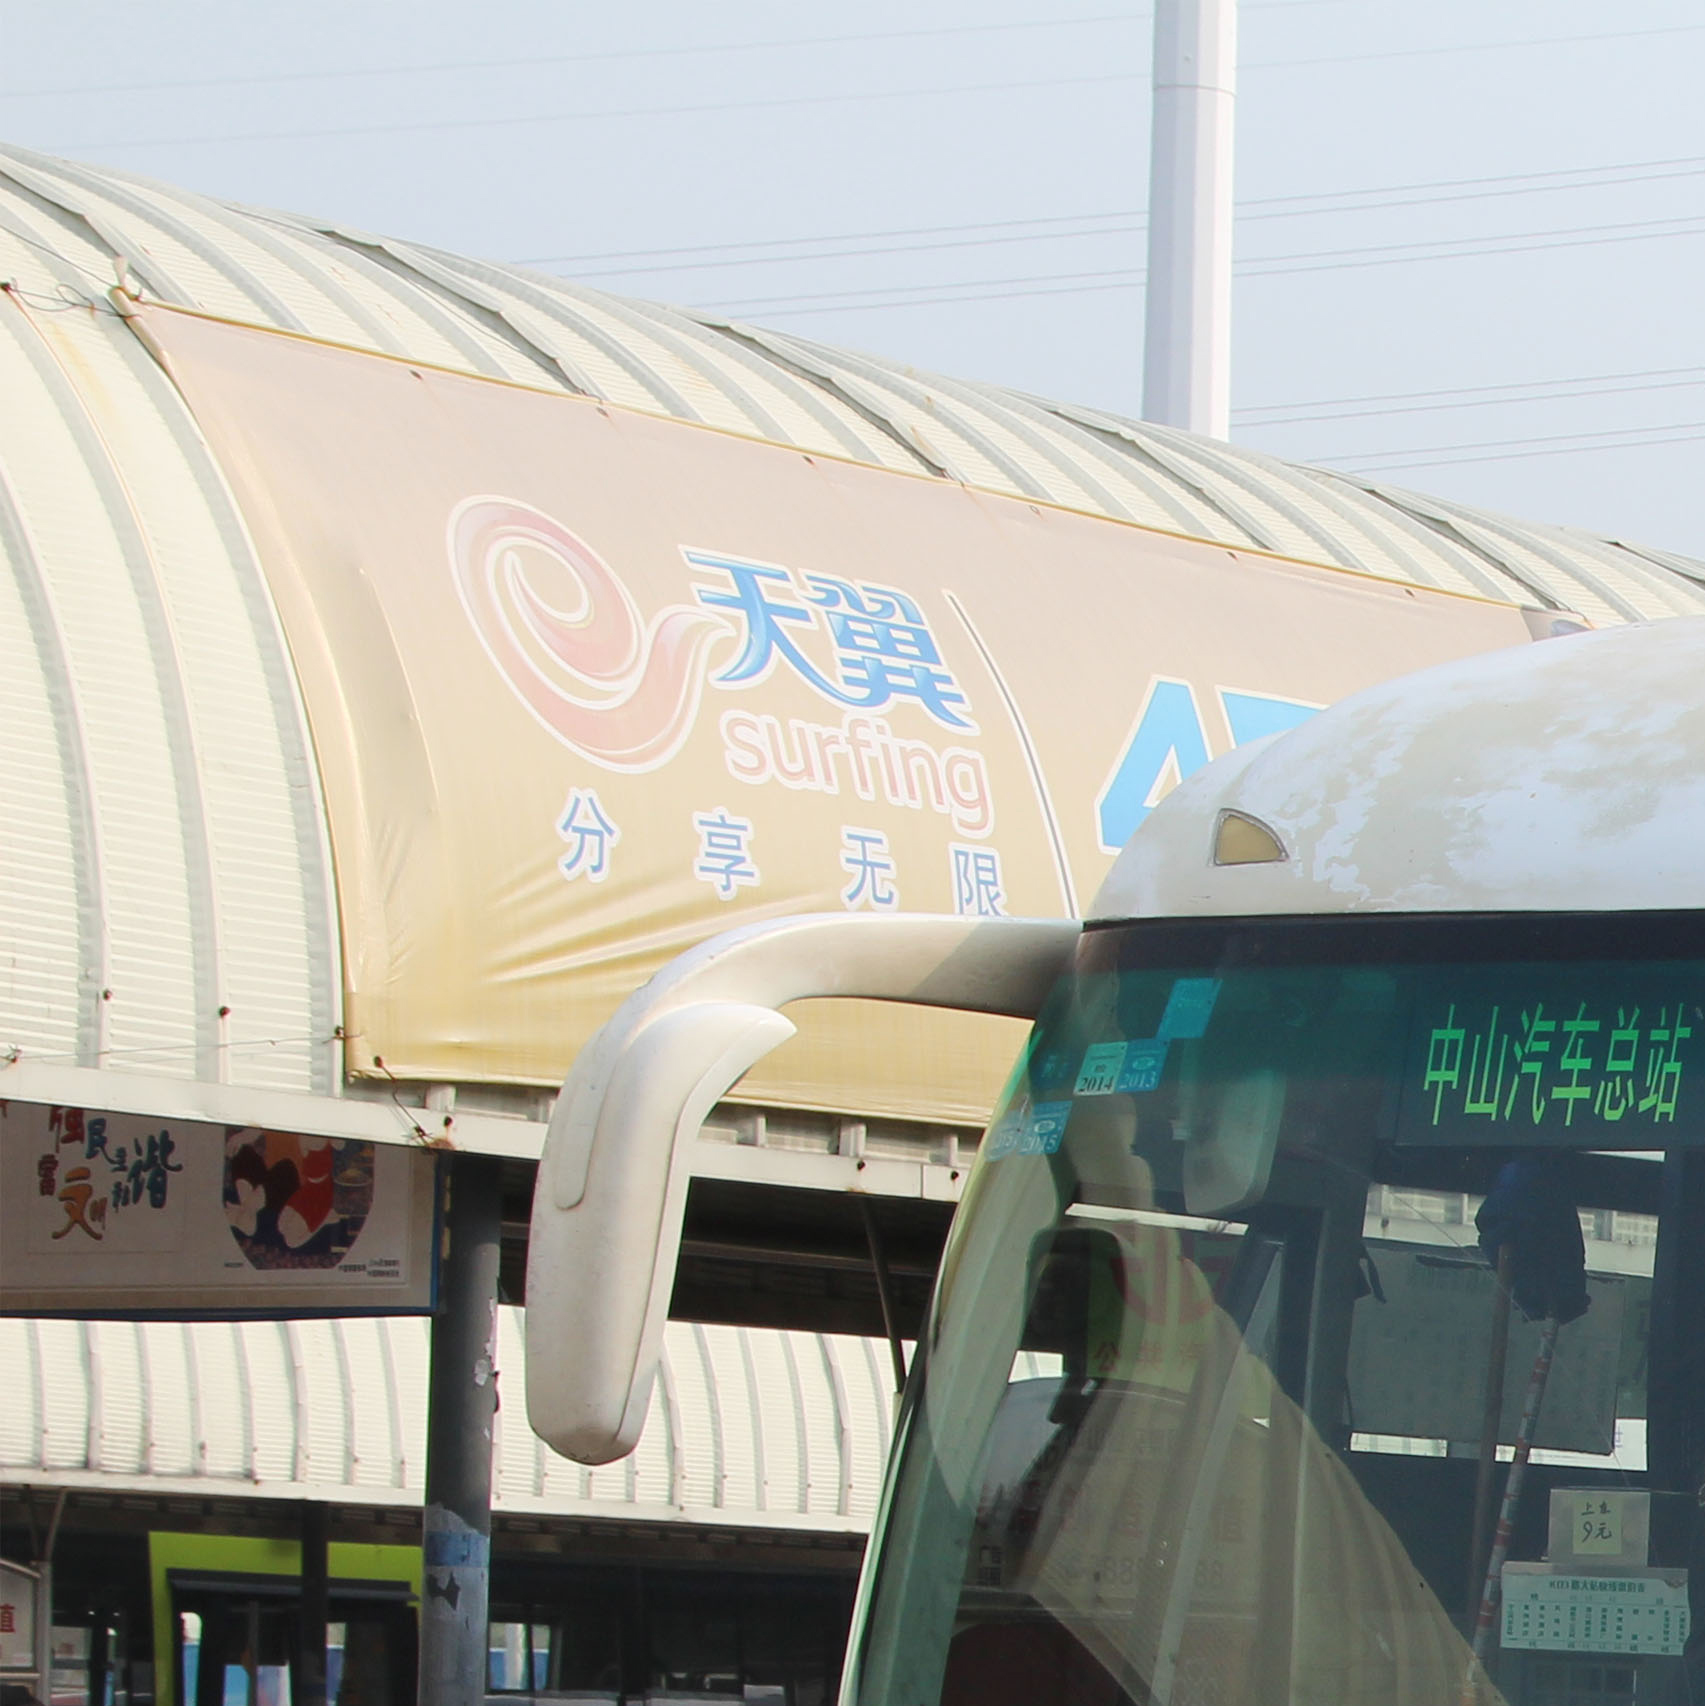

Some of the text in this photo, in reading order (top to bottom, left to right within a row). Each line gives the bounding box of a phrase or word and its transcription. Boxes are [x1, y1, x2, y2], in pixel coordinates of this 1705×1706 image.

[682, 546, 980, 733] 天翼
[724, 712, 990, 832] surfing
[560, 793, 1003, 914] 分享无限
[1078, 1075, 1114, 1093] 2014
[1422, 1003, 1689, 1126] 中山汽车总站
[1581, 1520, 1613, 1543] 9元
